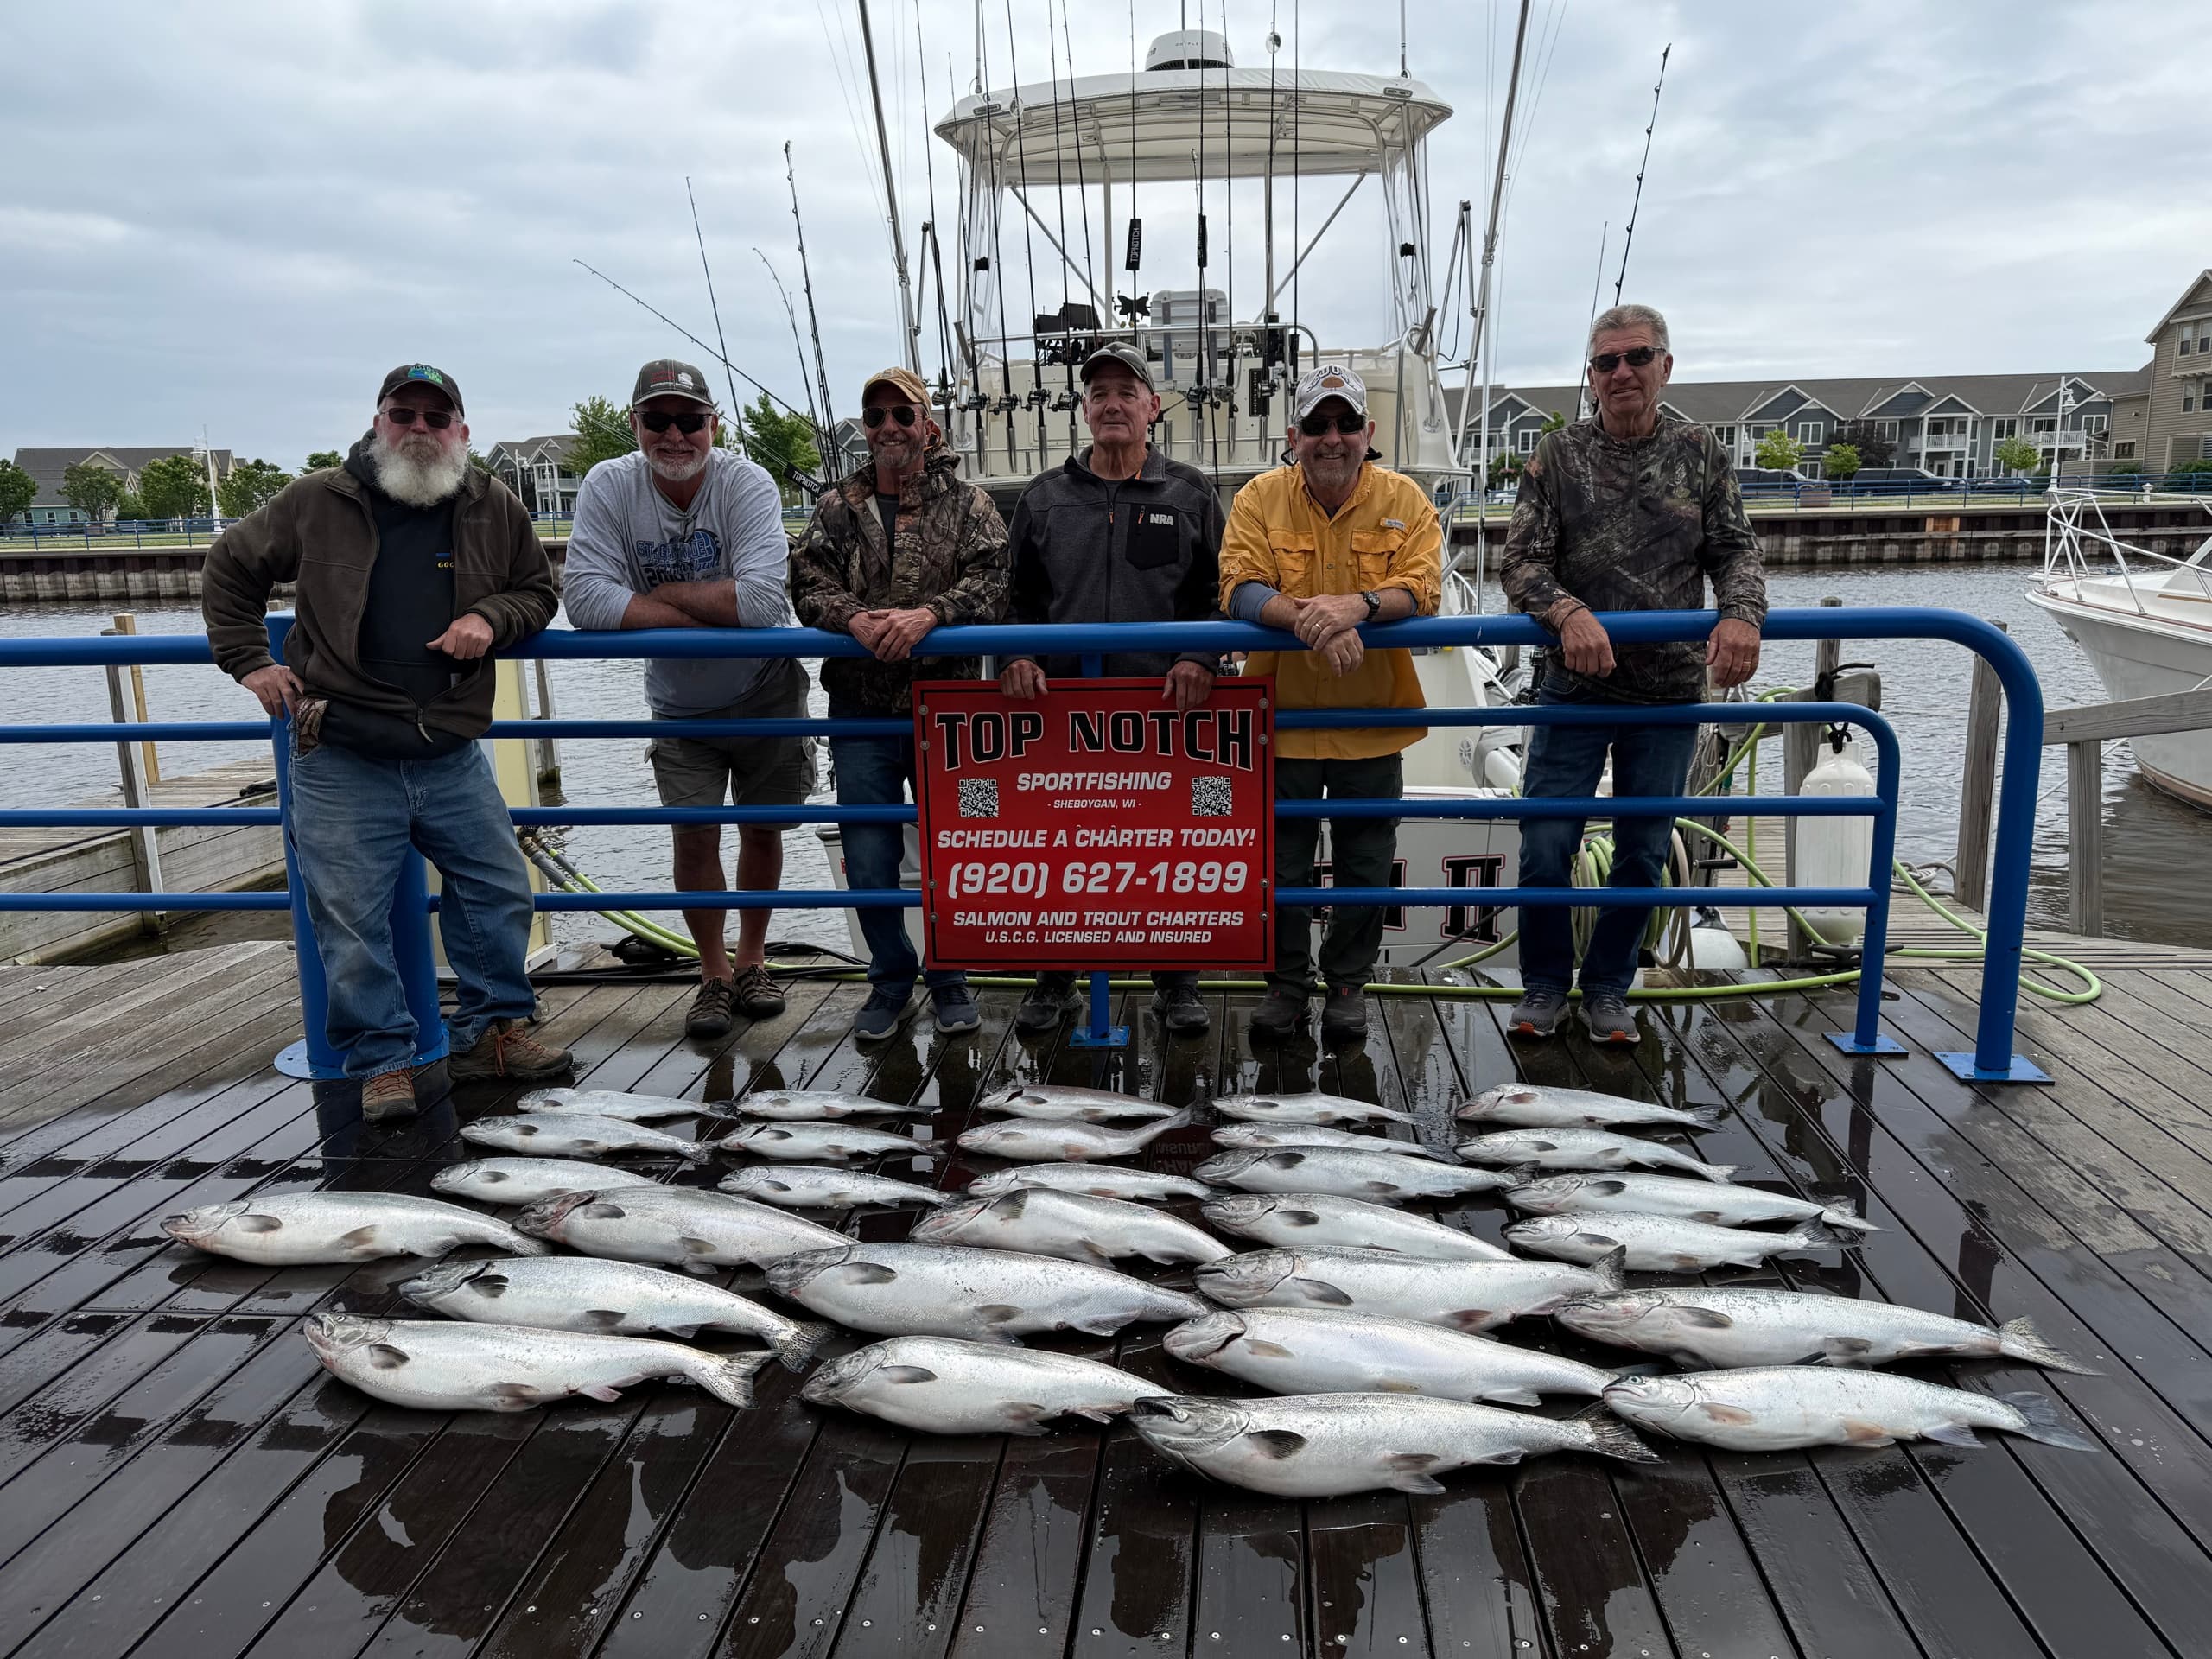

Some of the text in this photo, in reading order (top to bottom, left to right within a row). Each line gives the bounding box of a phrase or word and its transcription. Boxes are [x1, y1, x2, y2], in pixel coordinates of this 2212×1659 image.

[1129, 227, 1141, 263] TOPNOTCH
[792, 470, 821, 493] TOPNOTCH
[1149, 513, 1174, 525] NRA
[935, 709, 1253, 772] TOP NOTCH
[1016, 772, 1172, 791] SPORTFISHING
[1053, 798, 1119, 810] SHEBOYGAN,
[1122, 798, 1136, 809] WI
[937, 828, 1256, 849] SCHEDULE A CHARTER TODAY!
[948, 861, 1248, 899] (920) 627-1899
[953, 911, 1244, 926] SALMON AND TROUT CHARTERS
[985, 931, 1212, 943] U.S.C.G. LICENSED AND INSURED
